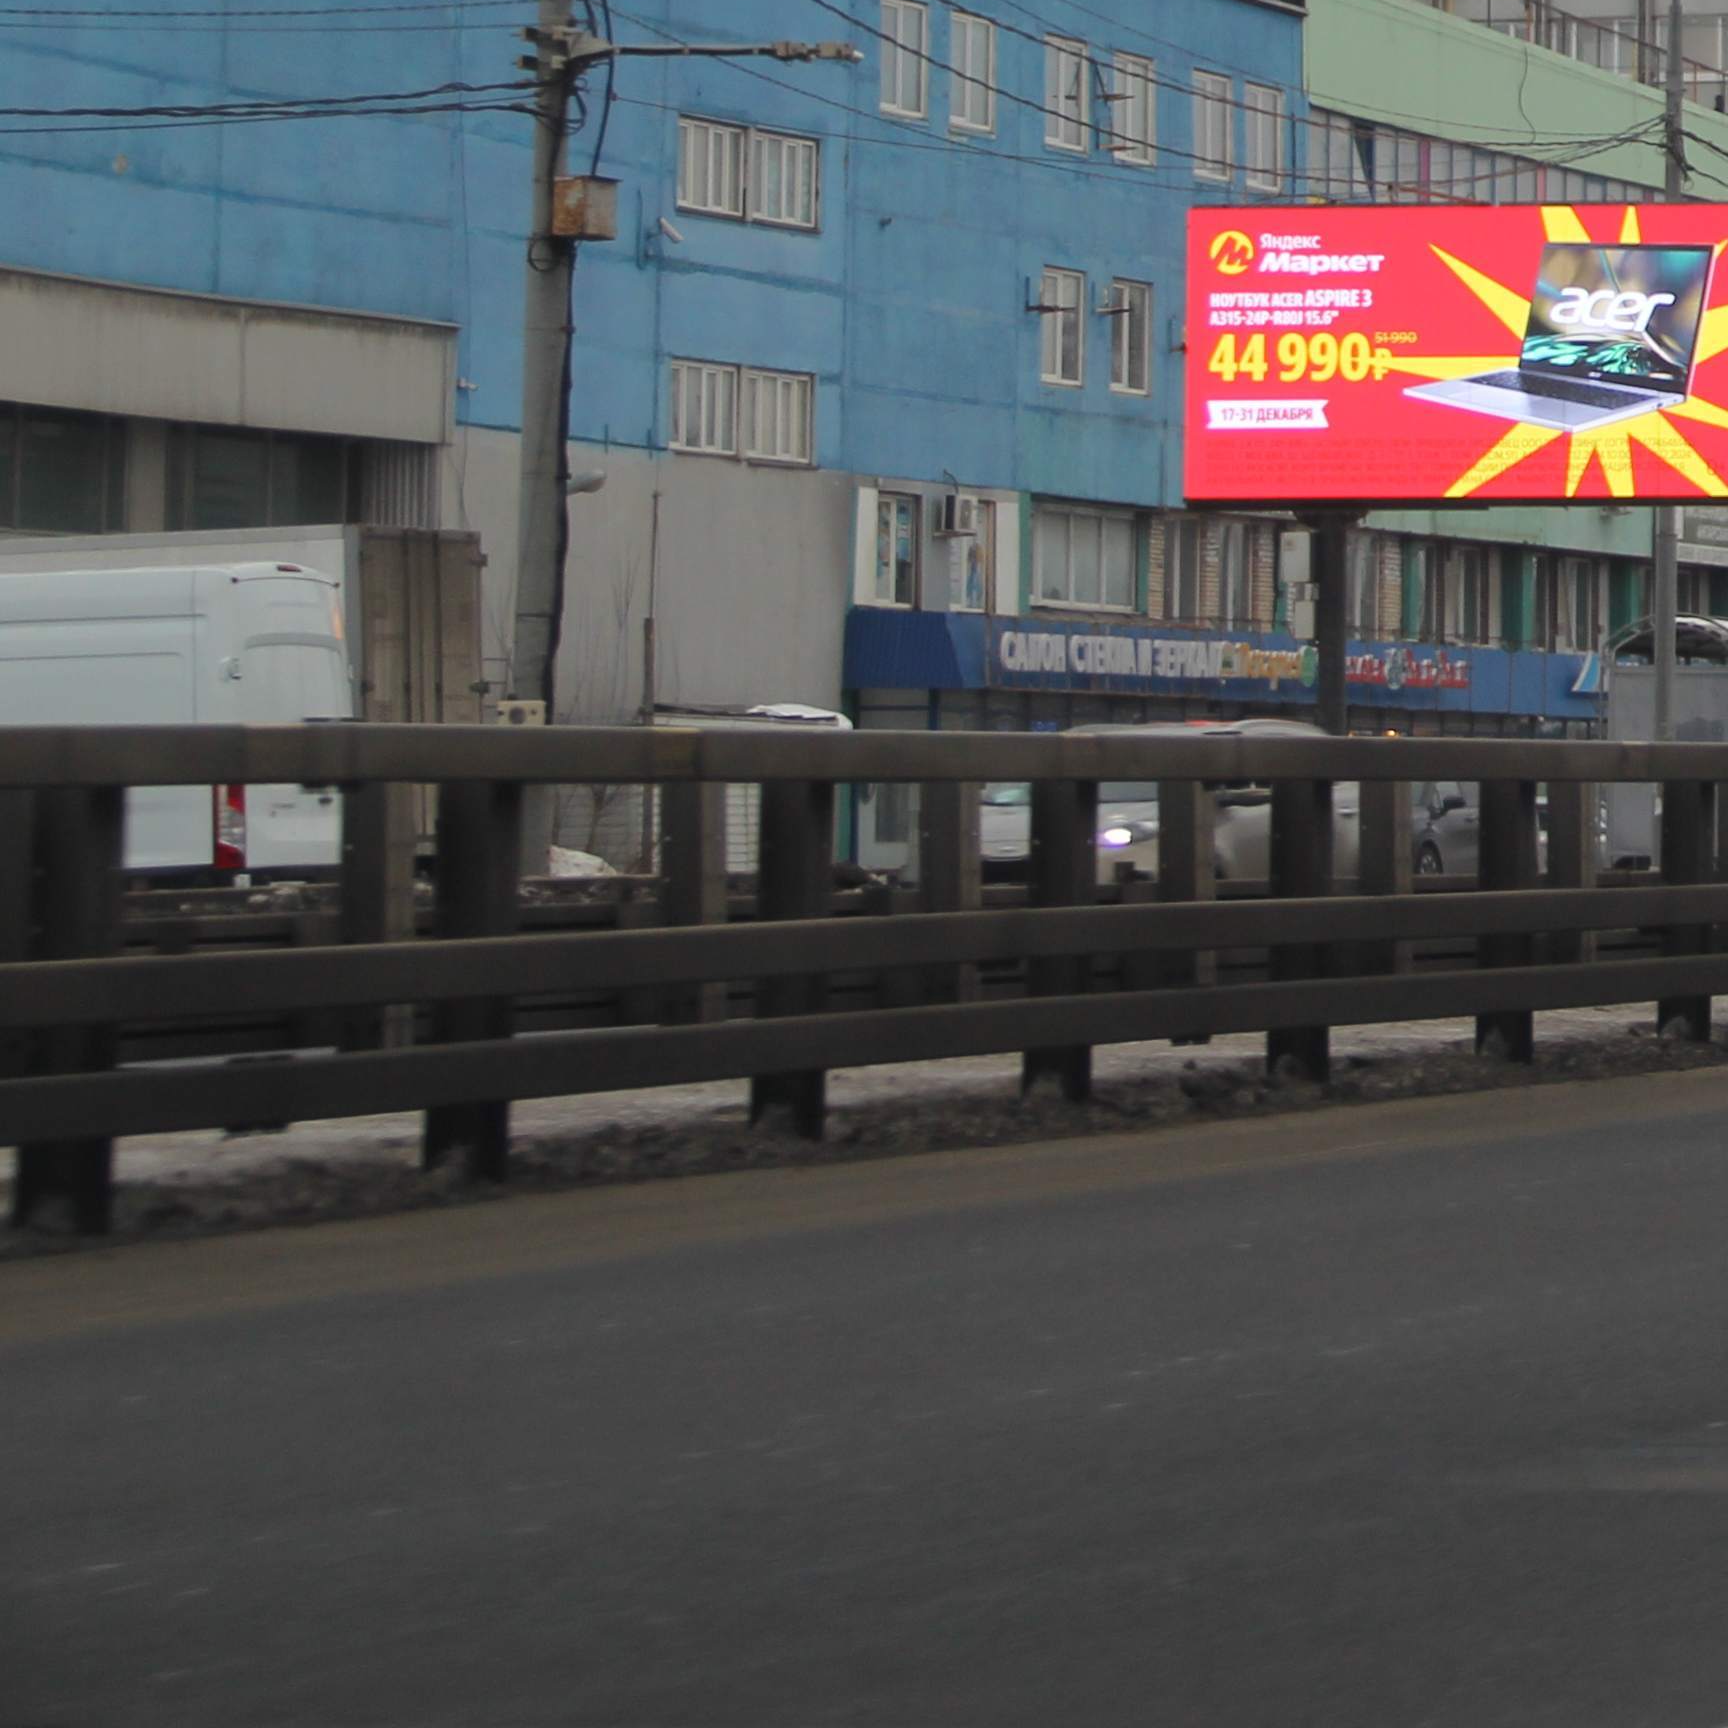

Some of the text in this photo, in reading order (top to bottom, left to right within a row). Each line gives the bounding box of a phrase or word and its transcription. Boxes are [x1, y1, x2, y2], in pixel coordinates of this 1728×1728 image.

[1260, 233, 1321, 250] Яндекс
[1259, 251, 1385, 275] Маркет
[1209, 289, 1373, 307] НОУТБУК ACER ASPIRE 3
[1550, 286, 1675, 331] acer
[1208, 334, 1268, 382] 44
[1221, 407, 1313, 423] 17-31 ДЕКАБРЯ
[1000, 631, 1066, 672] САЛОН
[1069, 634, 1136, 676] СТЕКЛА
